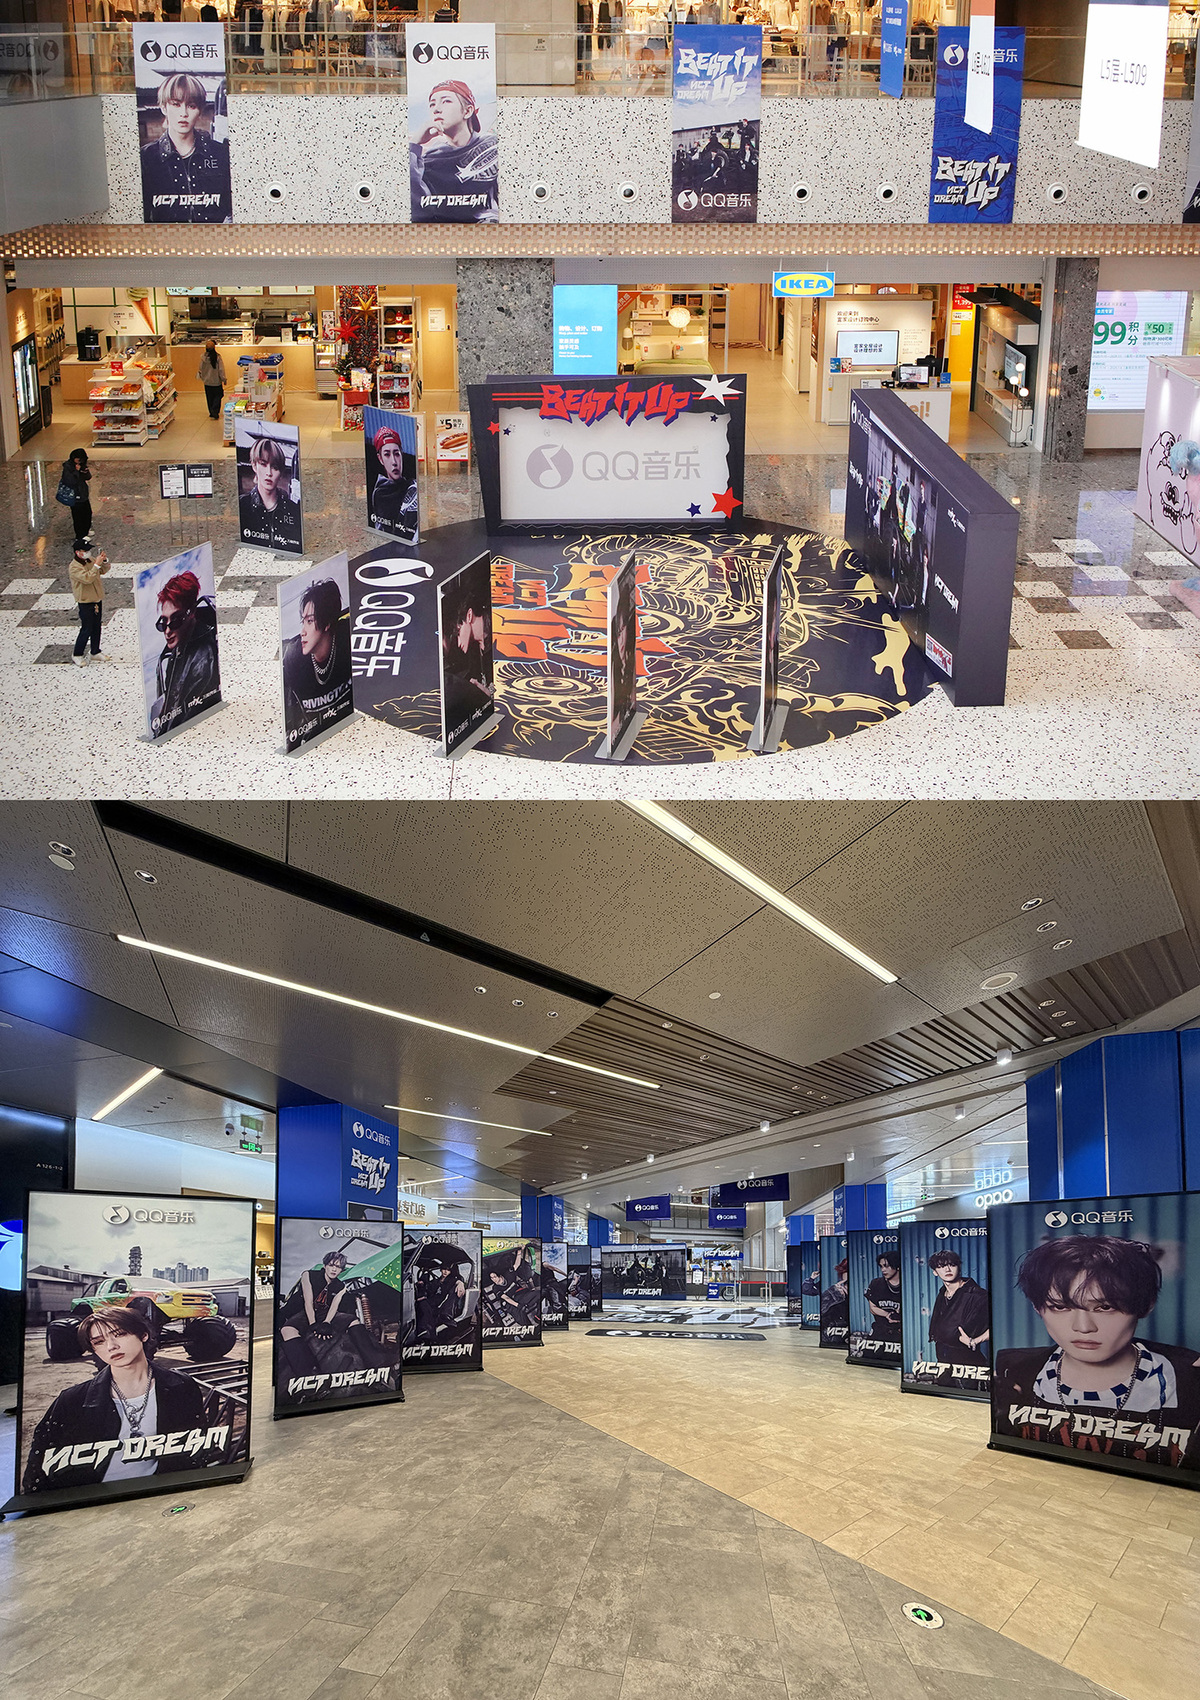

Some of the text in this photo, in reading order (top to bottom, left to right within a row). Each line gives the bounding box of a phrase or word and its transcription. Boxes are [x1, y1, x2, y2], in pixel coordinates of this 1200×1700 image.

[165, 43, 219, 59] QQ音乐
[437, 46, 490, 61] QQ音乐
[677, 46, 759, 81] BEAT IT
[712, 72, 748, 107] UP
[935, 154, 1012, 187] BEAT IT
[946, 185, 967, 195] NCT
[964, 178, 1000, 211] UP
[152, 193, 221, 208] NCT DREAM
[420, 194, 488, 208] NCT DREAM
[700, 193, 752, 208] QQ音乐
[933, 194, 965, 205] DREAM
[780, 278, 830, 290] IKEA
[1093, 321, 1127, 345] 99
[539, 381, 692, 426] BEAT IT UP
[904, 400, 932, 420] ej!
[582, 450, 702, 482] QQ音乐
[365, 1128, 391, 1147] QQ音乐
[351, 1147, 380, 1174] BEAT
[748, 1179, 775, 1187] QQ音乐
[975, 1188, 1013, 1210] oppo
[133, 1208, 196, 1225] QQ音乐
[641, 1204, 659, 1212] QQ音乐
[1070, 1209, 1134, 1226] QQ音乐
[335, 1227, 370, 1239] QQ音乐
[950, 1227, 988, 1237] QQ音乐
[622, 1288, 662, 1296] NCT DREAM
[542, 1313, 564, 1322] REAM
[502, 1325, 535, 1338] DREAM
[402, 1343, 474, 1360] NCT DREAM
[856, 1339, 901, 1354] NCT DR
[911, 1360, 990, 1382] NCT DRE
[287, 1366, 392, 1397] NCT DREAM
[1007, 1403, 1192, 1454] NCT DREAM
[41, 1425, 230, 1477] NCT DREAM
